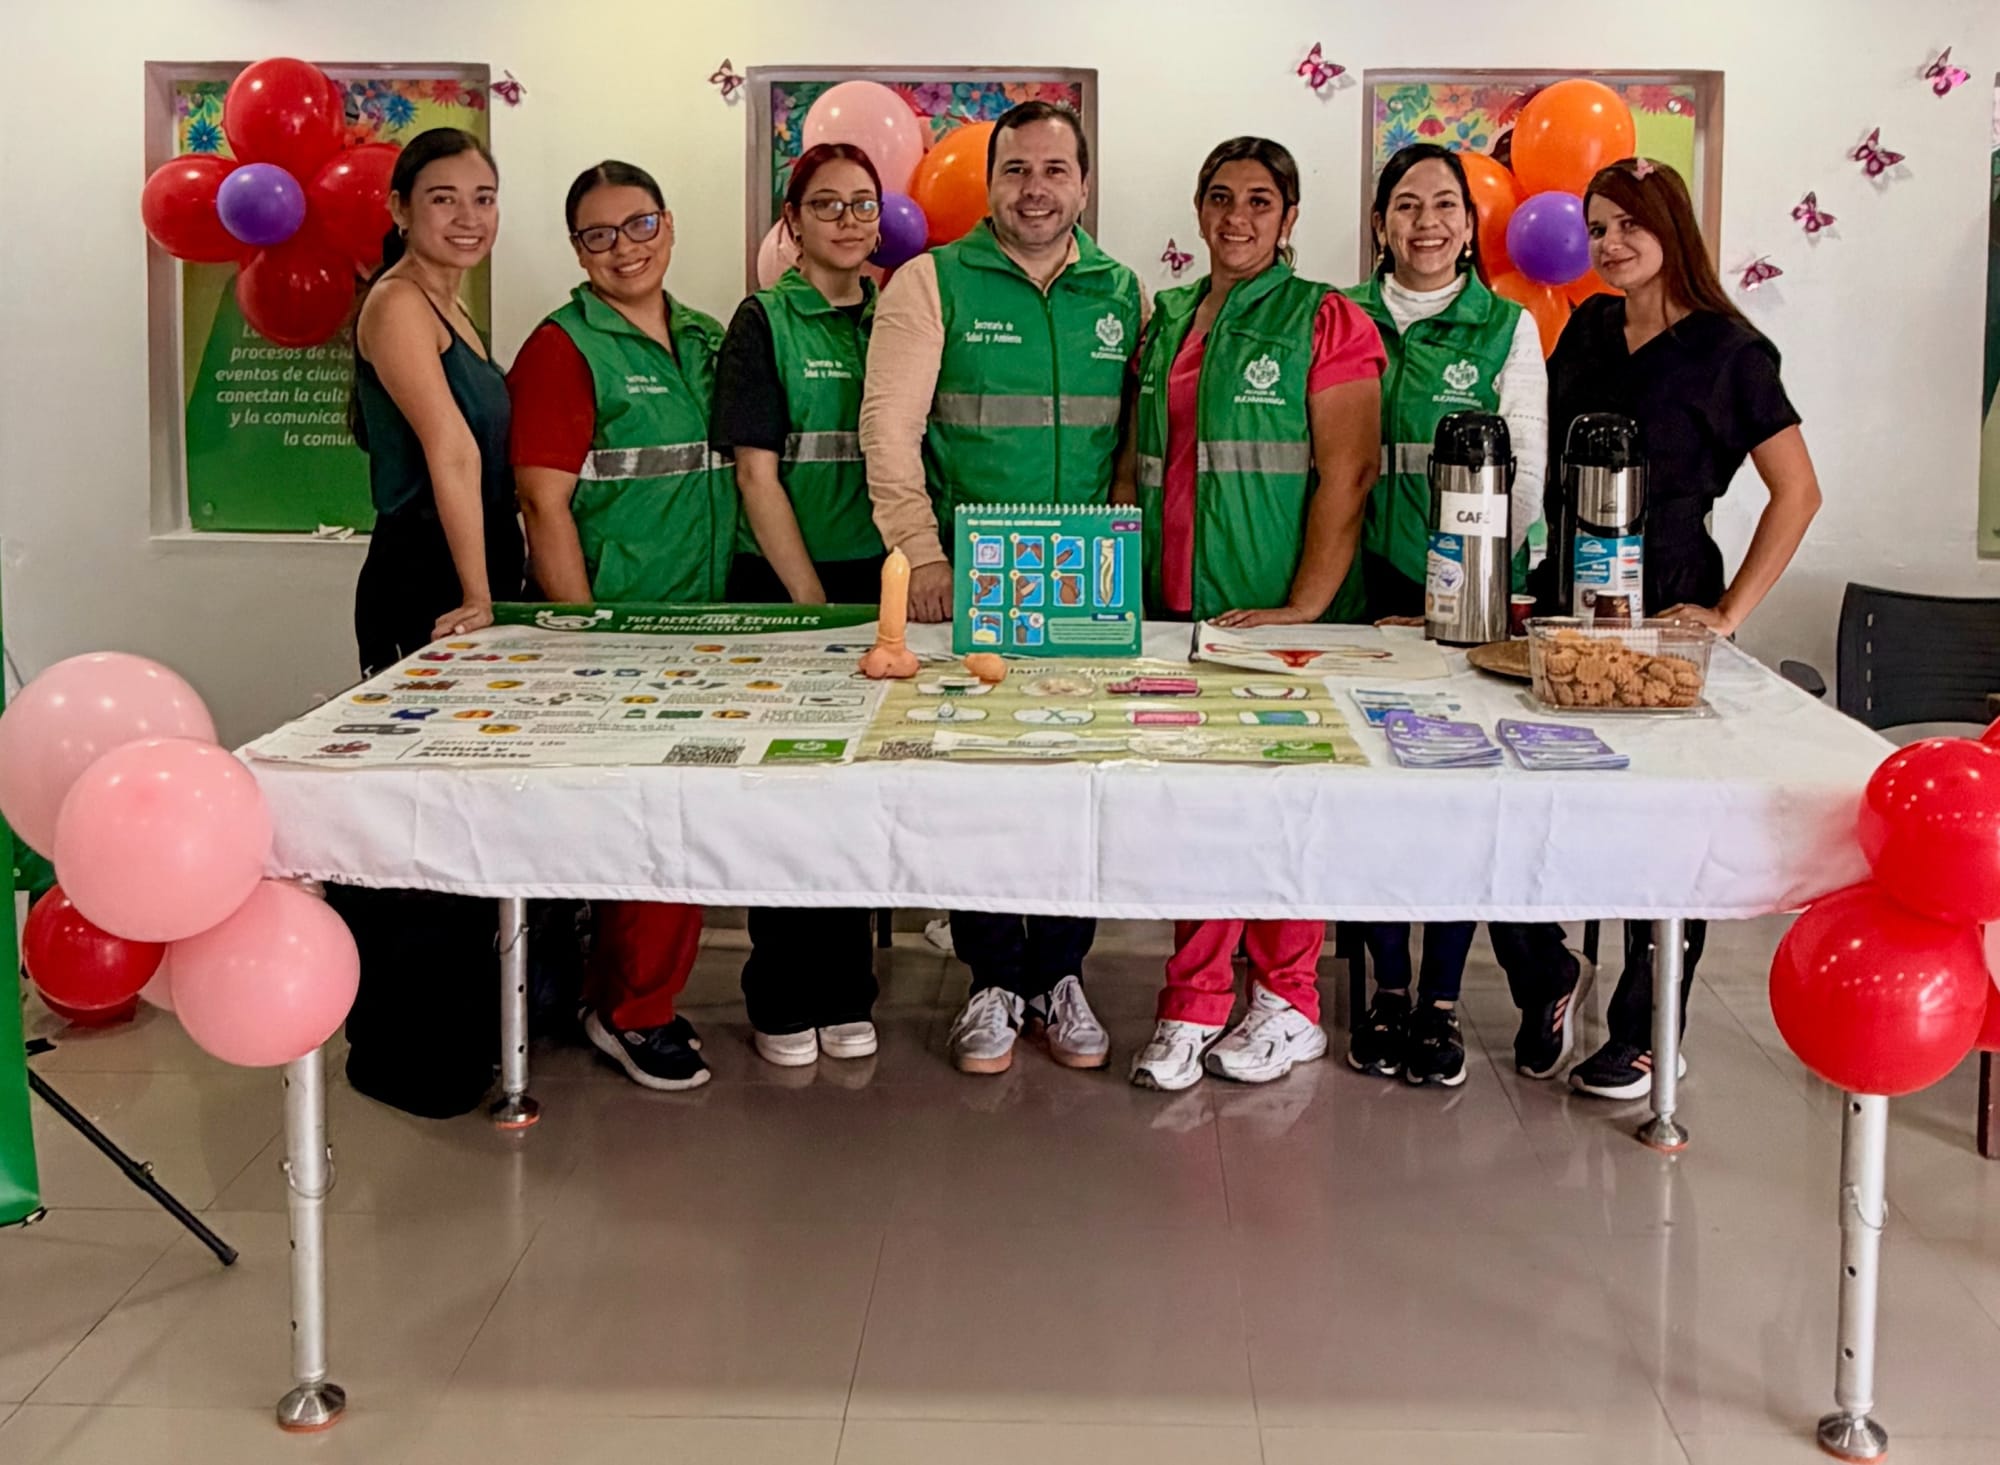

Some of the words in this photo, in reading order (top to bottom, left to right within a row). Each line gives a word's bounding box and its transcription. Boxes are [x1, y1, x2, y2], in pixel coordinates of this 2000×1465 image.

[230, 347, 302, 362] procesos
[306, 346, 326, 359] de
[329, 346, 353, 359] ciu
[216, 367, 280, 381] eventos
[282, 366, 302, 381] de
[306, 366, 353, 381] ciuda
[216, 388, 289, 402] conectan
[294, 387, 308, 402] la
[313, 387, 350, 402] cult
[229, 412, 241, 428] y
[244, 409, 259, 424] la
[283, 430, 298, 445] la
[303, 433, 356, 446] comun
[626, 615, 656, 624] TUS
[658, 614, 741, 625] DERECHOS
[743, 615, 821, 625] SEXUALES
[631, 624, 763, 632] REPRODUCTIVOS
